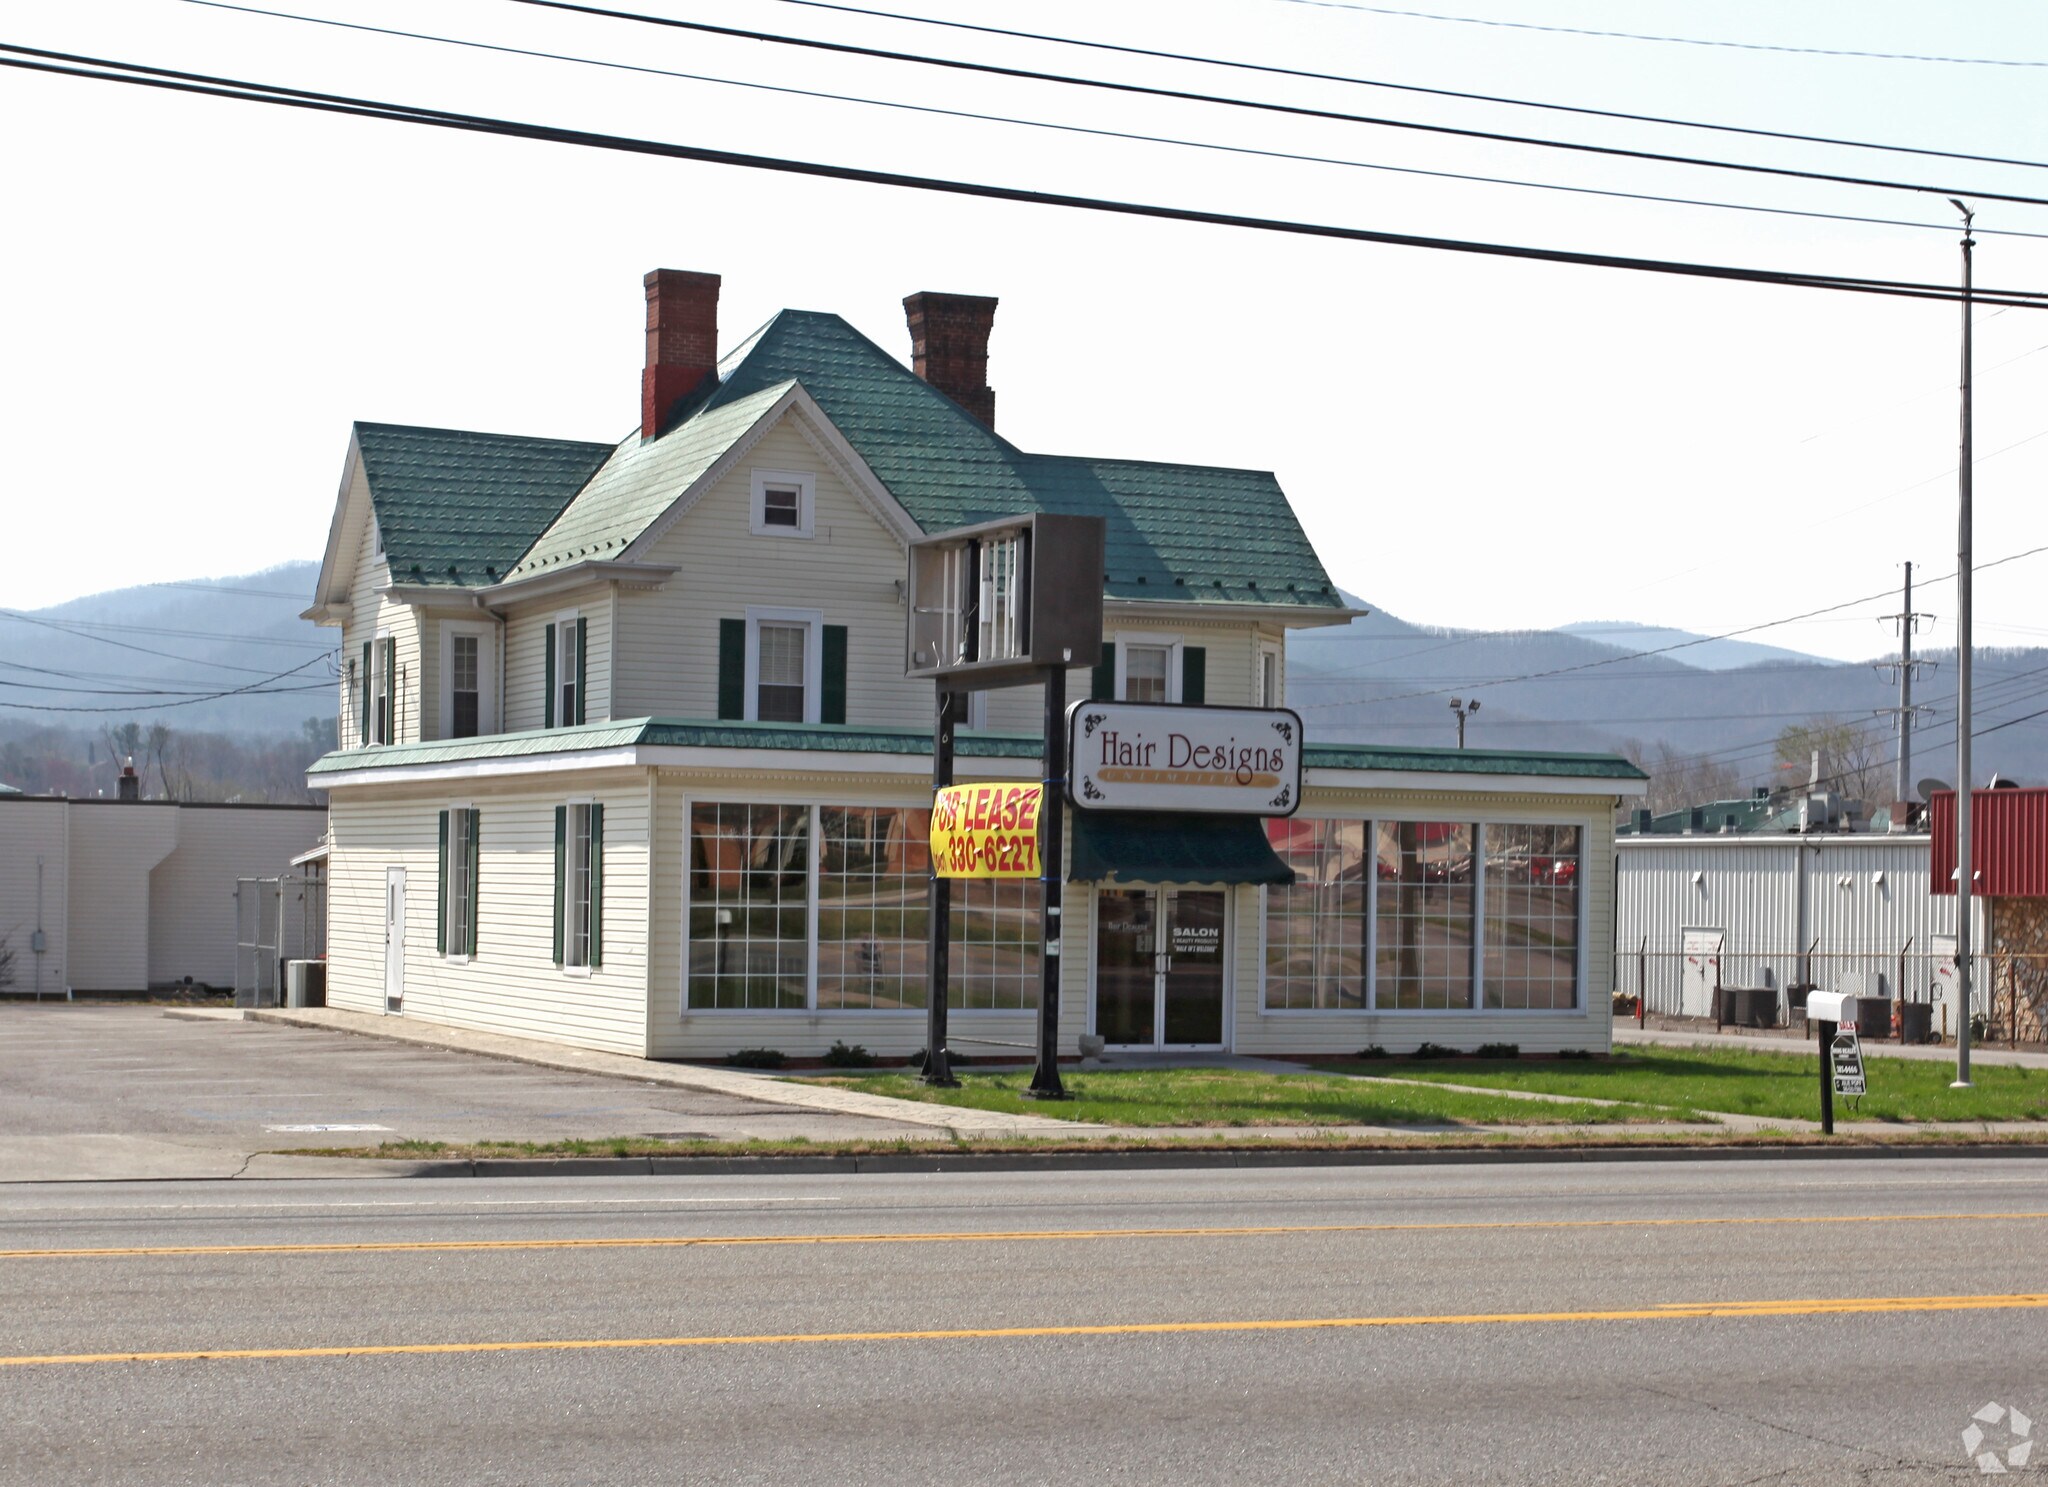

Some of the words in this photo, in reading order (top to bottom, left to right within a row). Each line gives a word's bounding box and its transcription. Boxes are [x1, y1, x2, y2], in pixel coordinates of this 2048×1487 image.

[1100, 731, 1156, 767] Hair
[1168, 733, 1284, 786] Designs
[1106, 770, 1234, 784] UNLIMITED
[932, 791, 961, 832] FOR
[964, 787, 1040, 831] LEASE
[949, 835, 1035, 873] 330-6227
[1173, 928, 1219, 937] SALON
